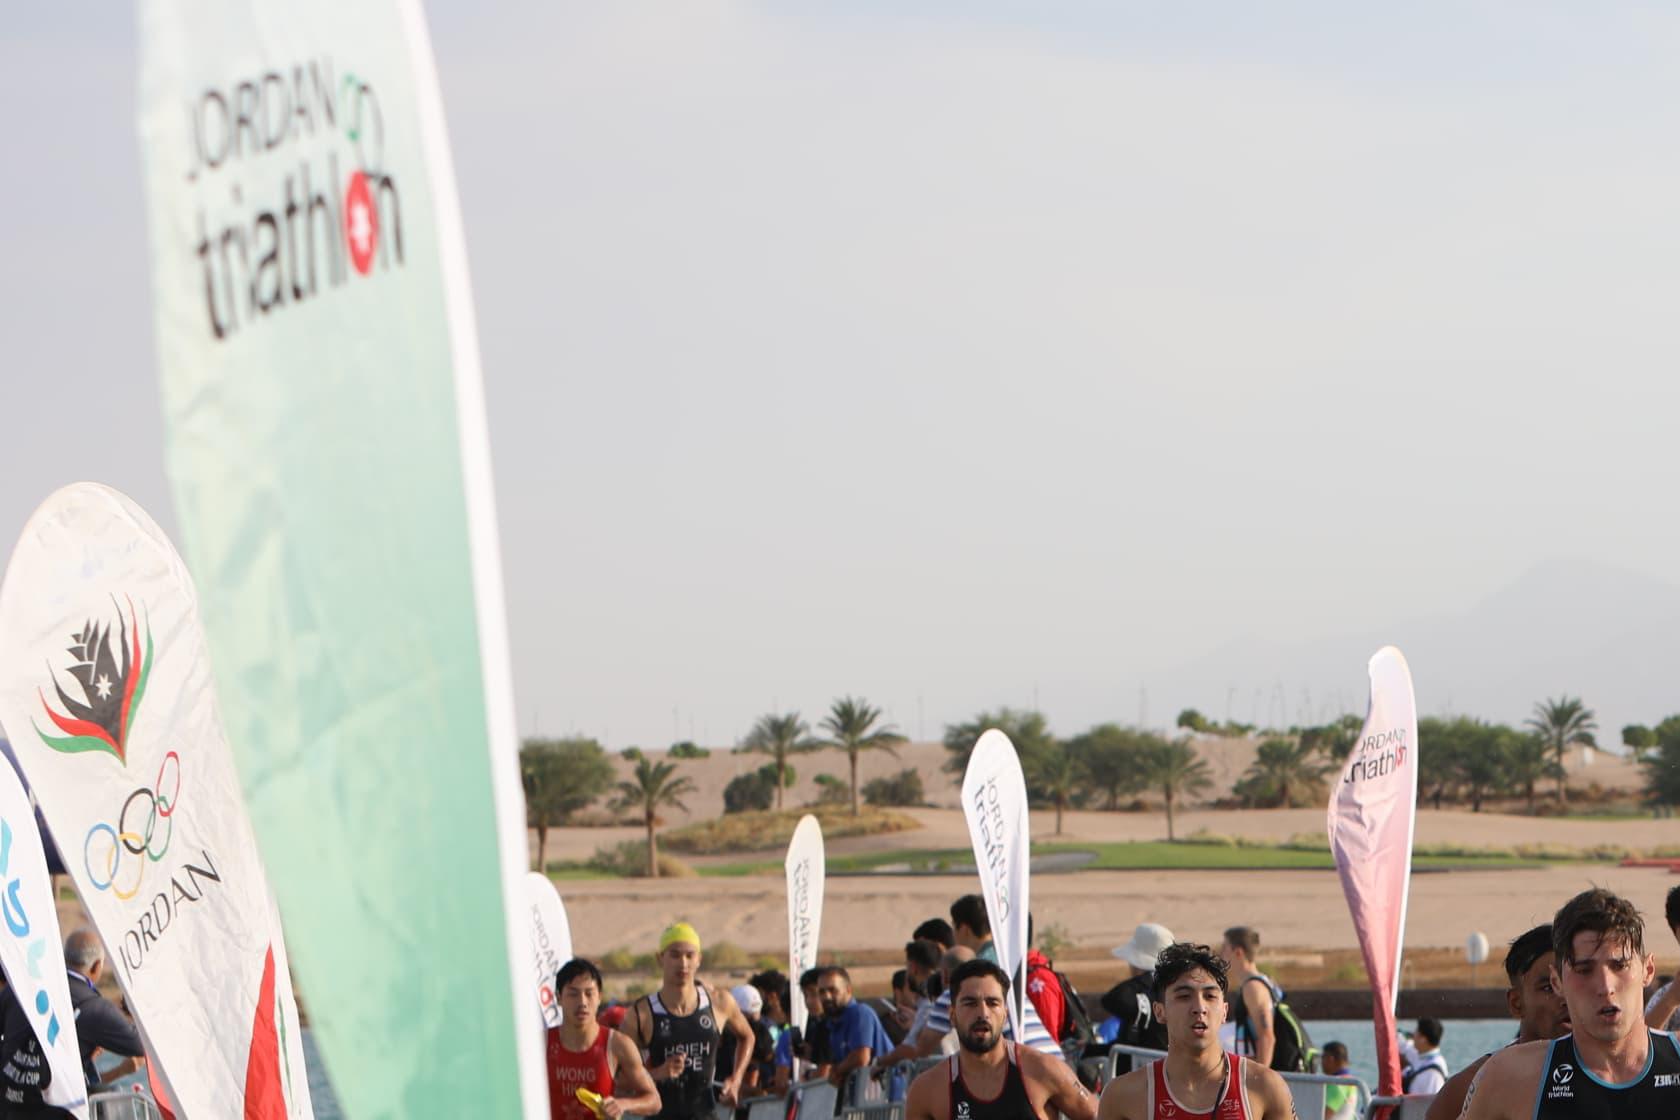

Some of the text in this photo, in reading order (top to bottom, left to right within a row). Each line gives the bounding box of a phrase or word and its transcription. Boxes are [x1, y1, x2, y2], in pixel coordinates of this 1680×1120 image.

[187, 58, 336, 182] JORDAN
[196, 152, 404, 341] triathlon
[118, 848, 222, 988] JORDAN
[556, 1066, 596, 1082] WONG
[562, 1083, 587, 1096] HK
